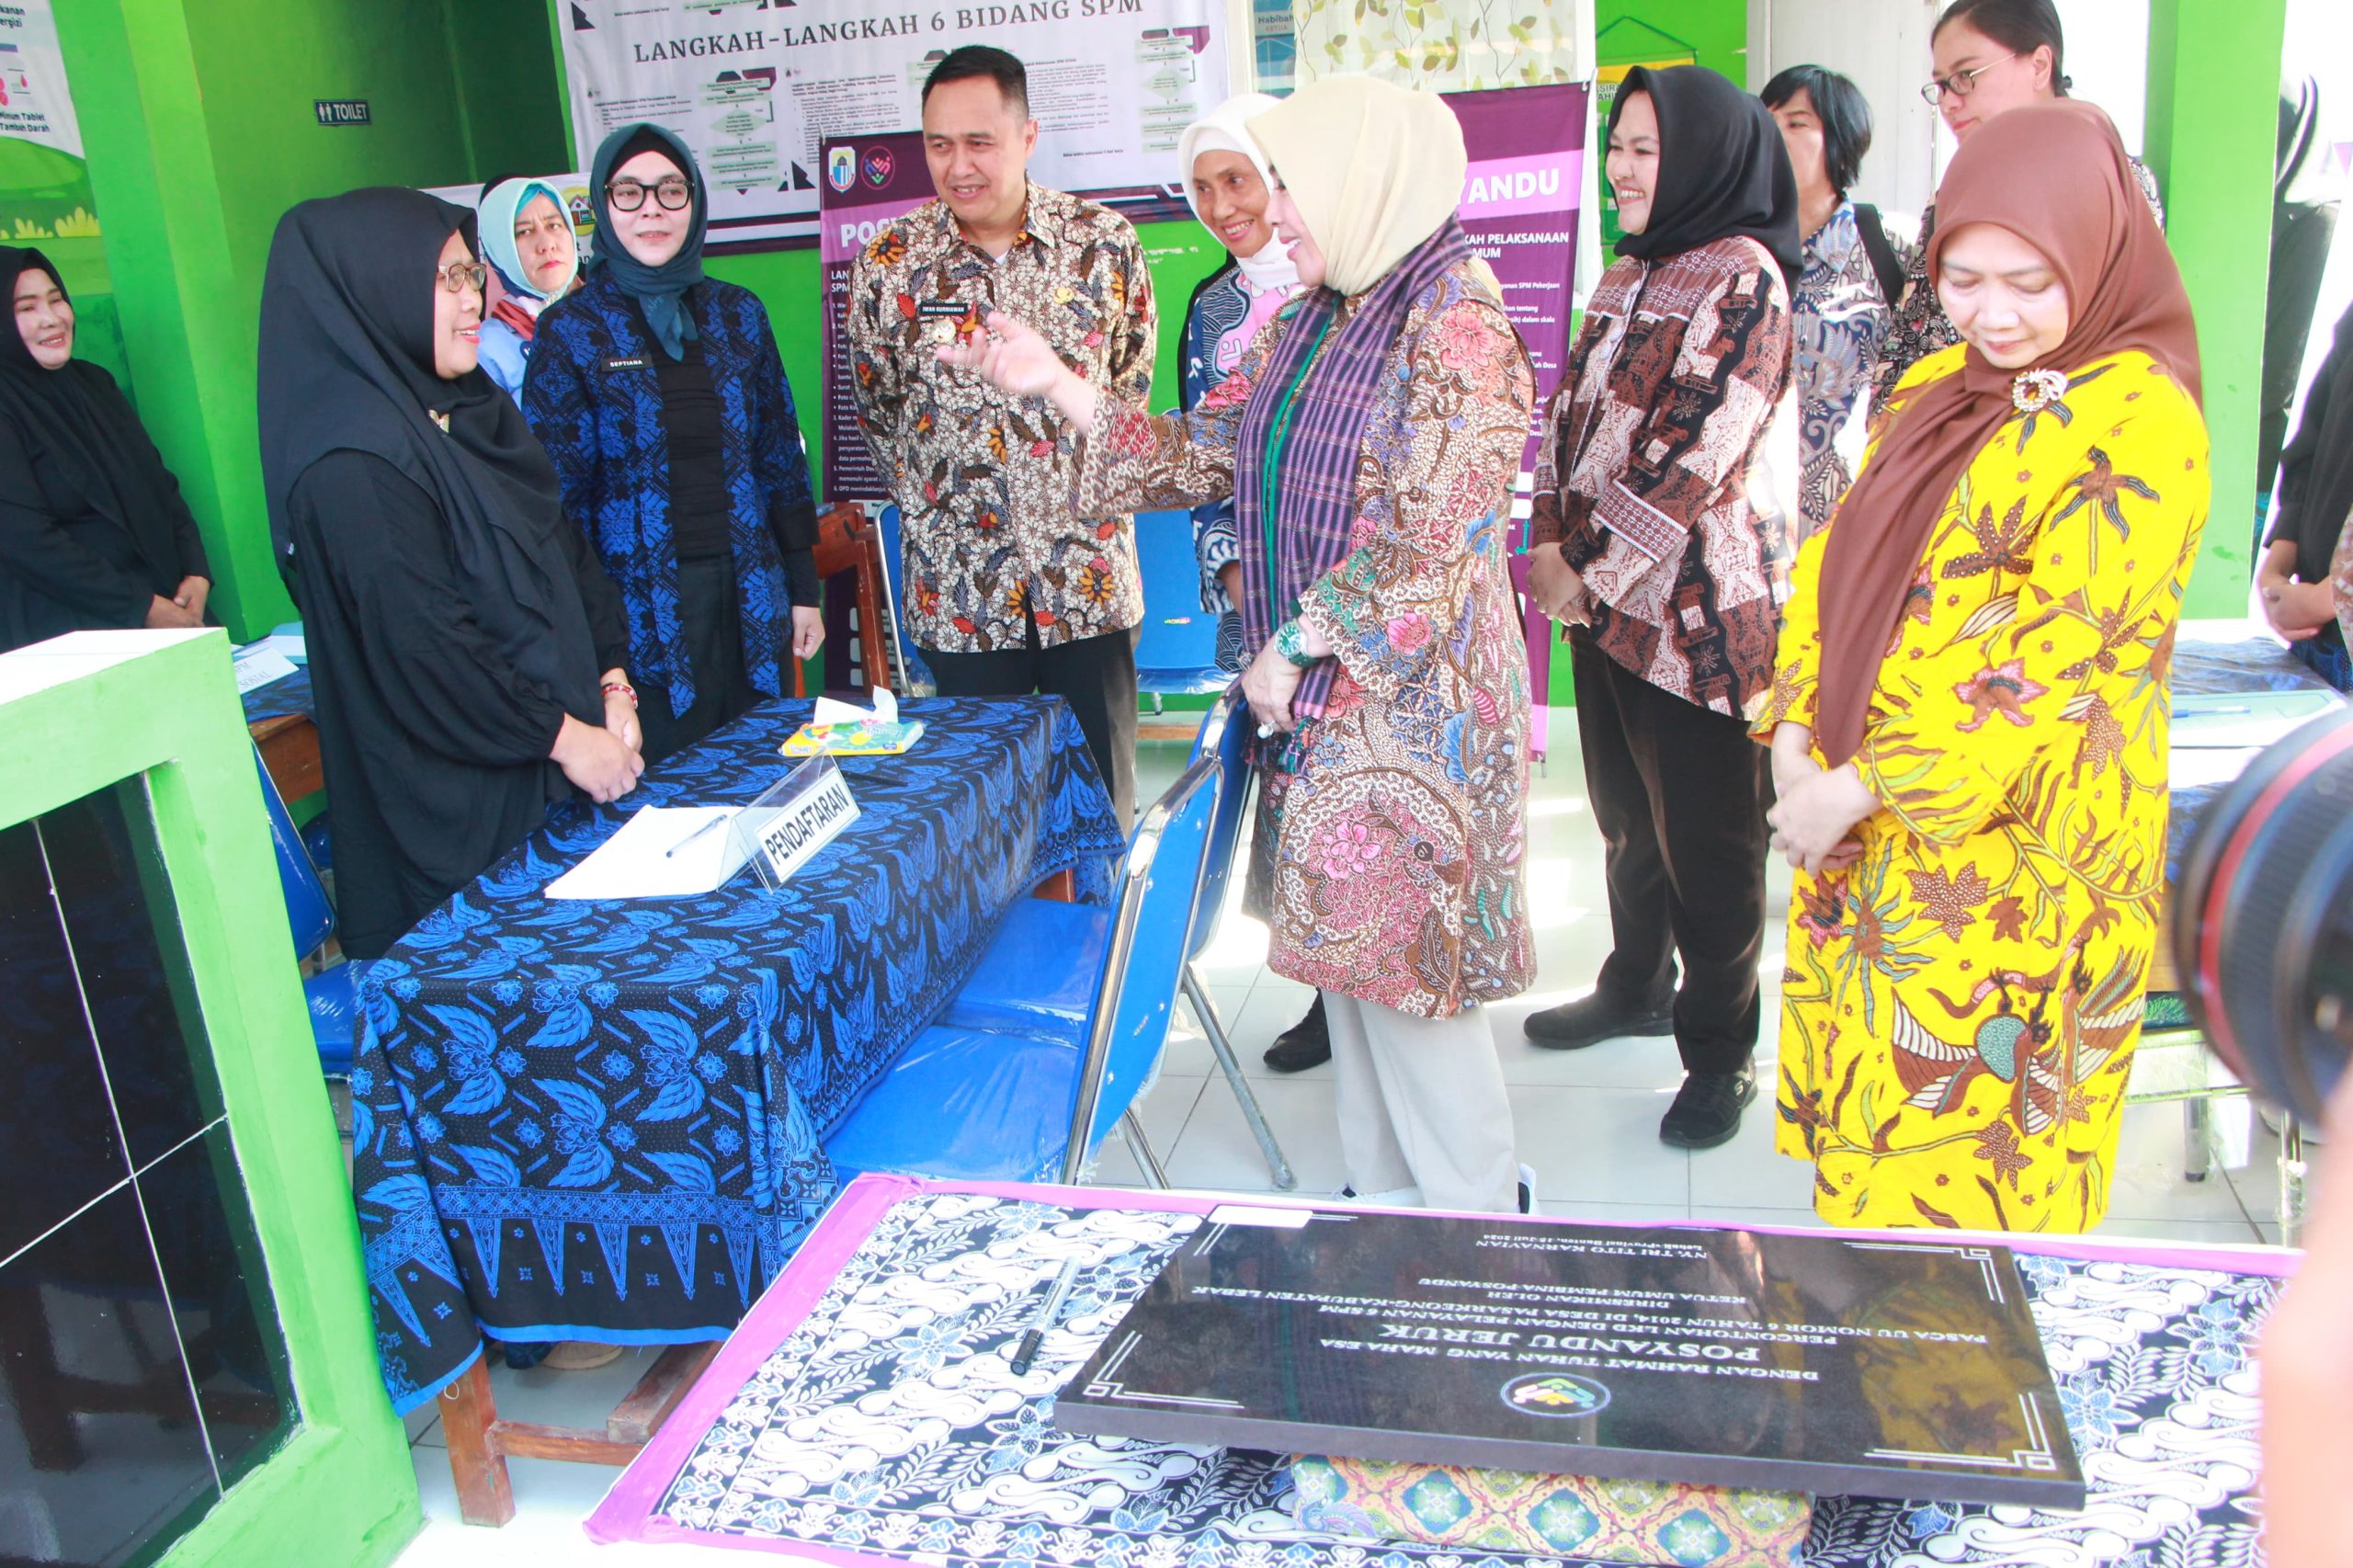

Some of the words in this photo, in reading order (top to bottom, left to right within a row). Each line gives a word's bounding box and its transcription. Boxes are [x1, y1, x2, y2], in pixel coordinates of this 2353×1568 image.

[634, 15, 918, 63] LANGKAH-LANGKAH
[931, 11, 946, 32] 6
[957, 1, 1070, 30] BIDANG
[1082, 0, 1143, 17] SPM
[21, 112, 46, 121] Tablet
[333, 103, 368, 121] TOILET
[27, 123, 51, 132] Darah
[840, 217, 897, 248] POS
[1487, 232, 1569, 244] PELAKSANAAN
[1532, 281, 1560, 290] Pekerjaan
[1517, 305, 1539, 313] tentang
[609, 359, 643, 368] SEPTIANA
[765, 782, 850, 866] PENDAFTARAN
[1475, 1239, 1586, 1253] KARNAVIAN
[1590, 1245, 1635, 1256] TITO
[1641, 1248, 1673, 1257] TRI
[1677, 1250, 1707, 1259] NY.
[1191, 1286, 1261, 1298] LEBAK
[1487, 1290, 1540, 1301] OLEH
[1613, 1289, 1675, 1299] UMUM
[1545, 1294, 1670, 1309] DIRESMIKAN
[1680, 1293, 1746, 1304] KETUA
[1318, 1303, 1362, 1314] SPM
[1366, 1307, 1378, 1315] 6
[1544, 1309, 1592, 1319] DESA
[1381, 1308, 1508, 1324] PELAYANAN
[1602, 1312, 1628, 1321] DI
[1633, 1313, 1681, 1324] 2014,
[1514, 1317, 1606, 1331] DENGAN
[1611, 1323, 1658, 1334] LKD
[1686, 1317, 1763, 1330] TAHUN
[1768, 1323, 1779, 1331] 6
[1783, 1323, 1870, 1336] NOMOR
[1378, 1324, 1519, 1346] JERUK
[1664, 1325, 1837, 1345] PERCONTOHAN
[1877, 1329, 1909, 1338] UU
[1913, 1331, 1986, 1343] PASCA
[1320, 1338, 1360, 1349] ESA
[1366, 1342, 1437, 1356] MAHA
[1528, 1334, 1759, 1361] POSYANDU
[1447, 1347, 1511, 1360] YANG
[1517, 1352, 1599, 1367] TUHAN
[1604, 1358, 1710, 1374] RAHMAT
[1716, 1365, 1819, 1381] DENGAN
